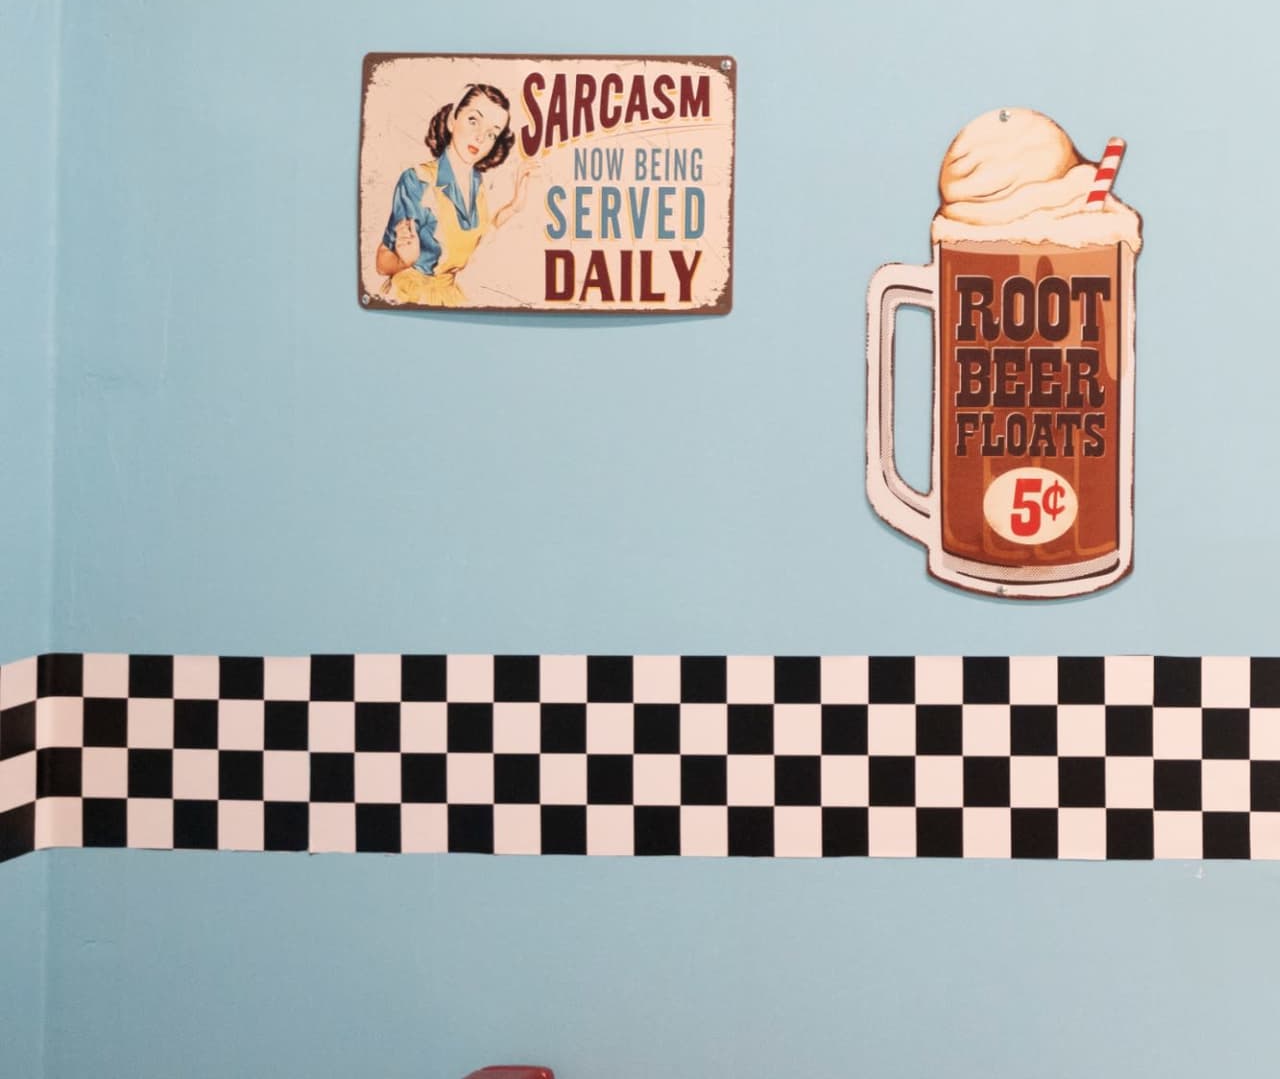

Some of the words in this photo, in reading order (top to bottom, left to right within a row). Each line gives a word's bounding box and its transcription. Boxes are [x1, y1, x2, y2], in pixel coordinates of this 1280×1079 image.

[520, 72, 711, 158] SARCASM
[574, 147, 625, 181] NOW
[635, 147, 703, 181] BEING
[544, 185, 706, 241] SERVED
[544, 249, 703, 303] DAILY
[955, 275, 1112, 343] ROOT
[955, 346, 1106, 409] BEER
[955, 412, 1106, 458] FLOATS
[1010, 478, 1067, 538] 5¢
